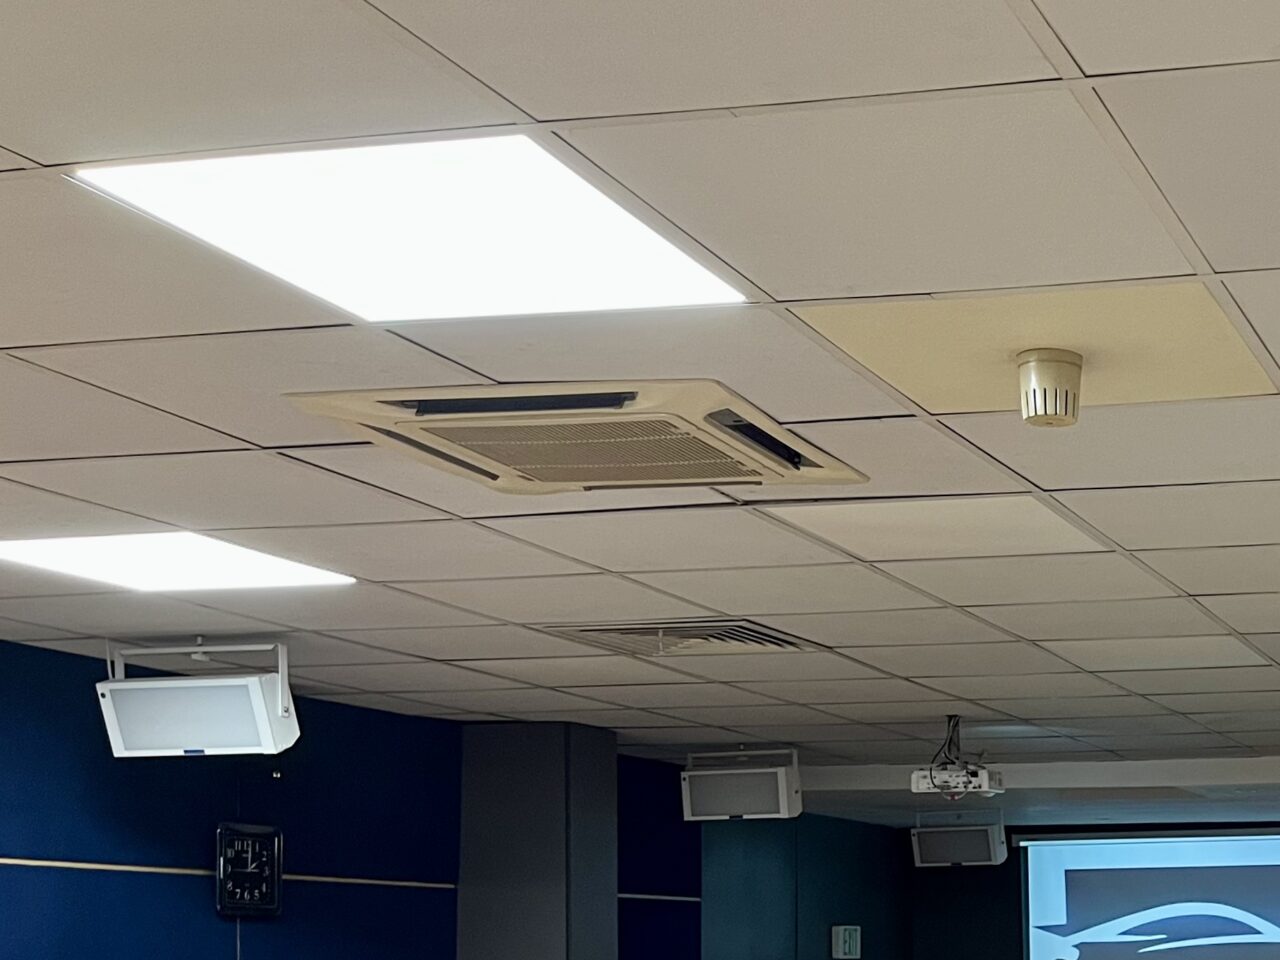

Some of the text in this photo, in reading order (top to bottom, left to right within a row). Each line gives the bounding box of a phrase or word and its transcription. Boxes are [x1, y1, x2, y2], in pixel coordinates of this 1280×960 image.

[262, 851, 267, 860] 2
[227, 880, 233, 891] 8
[235, 889, 260, 900] 7 6 5
